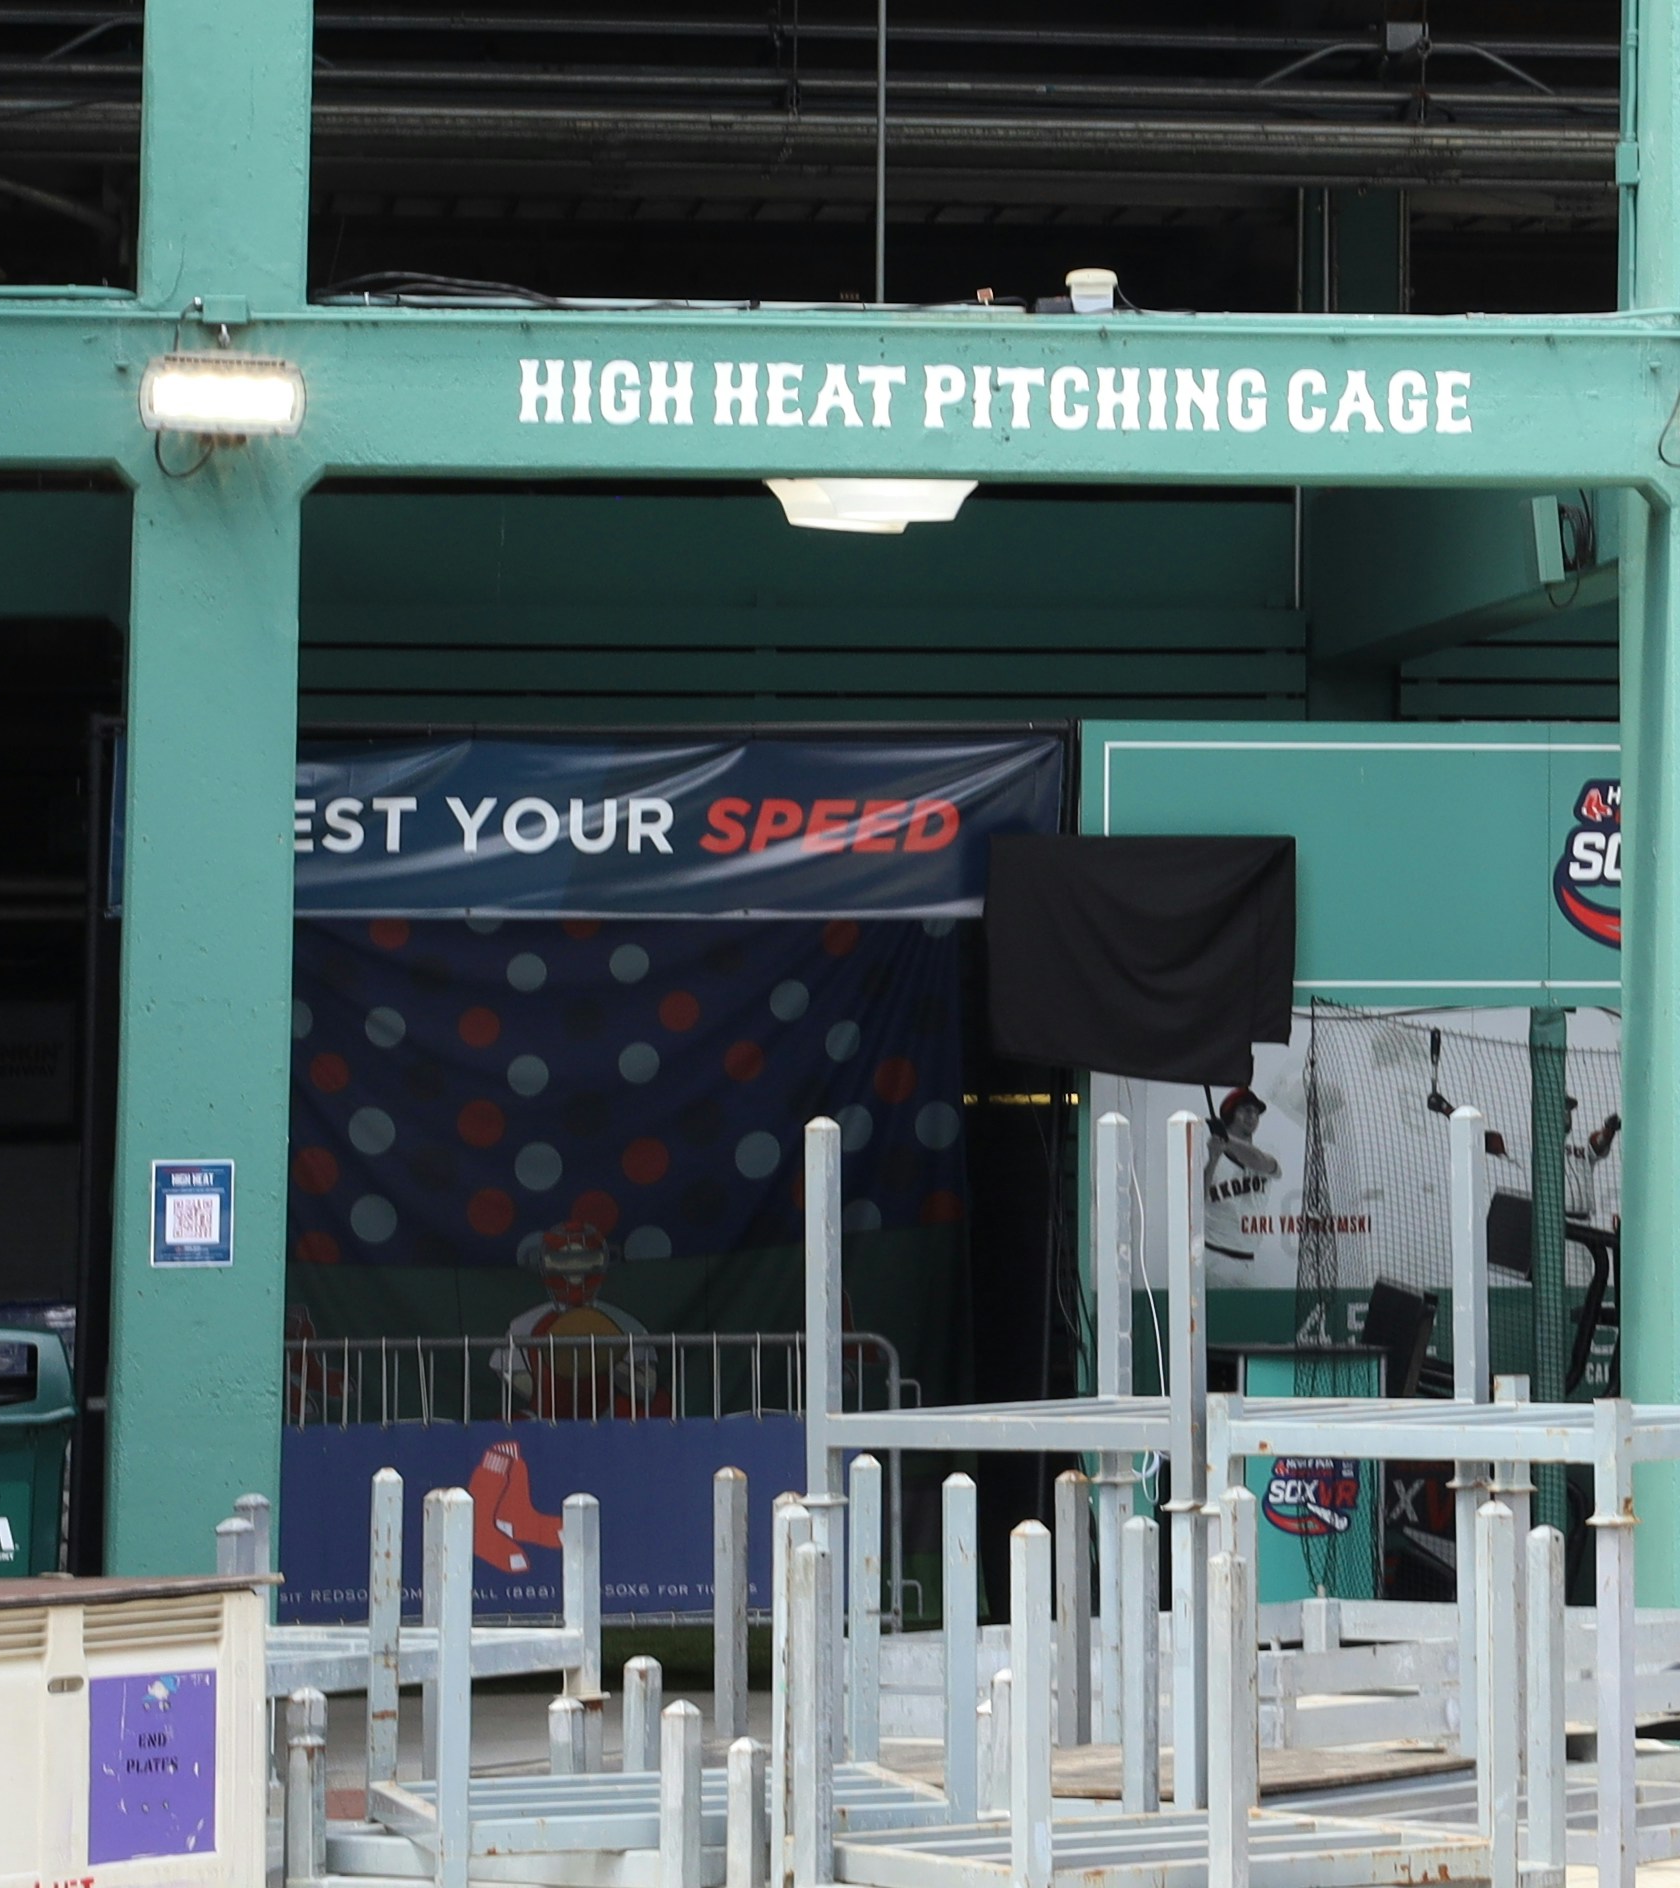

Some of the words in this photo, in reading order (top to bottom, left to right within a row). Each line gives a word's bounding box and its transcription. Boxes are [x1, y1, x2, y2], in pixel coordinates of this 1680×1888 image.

[519, 357, 695, 426] HIGH
[713, 361, 907, 429] HEAT
[923, 364, 1268, 434] PITCHING
[1287, 367, 1474, 437] CAGE
[294, 796, 418, 855] EST
[446, 796, 675, 857] YOUR
[698, 797, 960, 857] SPEED
[1241, 1214, 1274, 1234] CARL
[280, 1592, 301, 1604] SIT
[472, 1590, 498, 1601] ALL
[138, 1731, 168, 1750] END
[125, 1755, 179, 1775] PLATES
